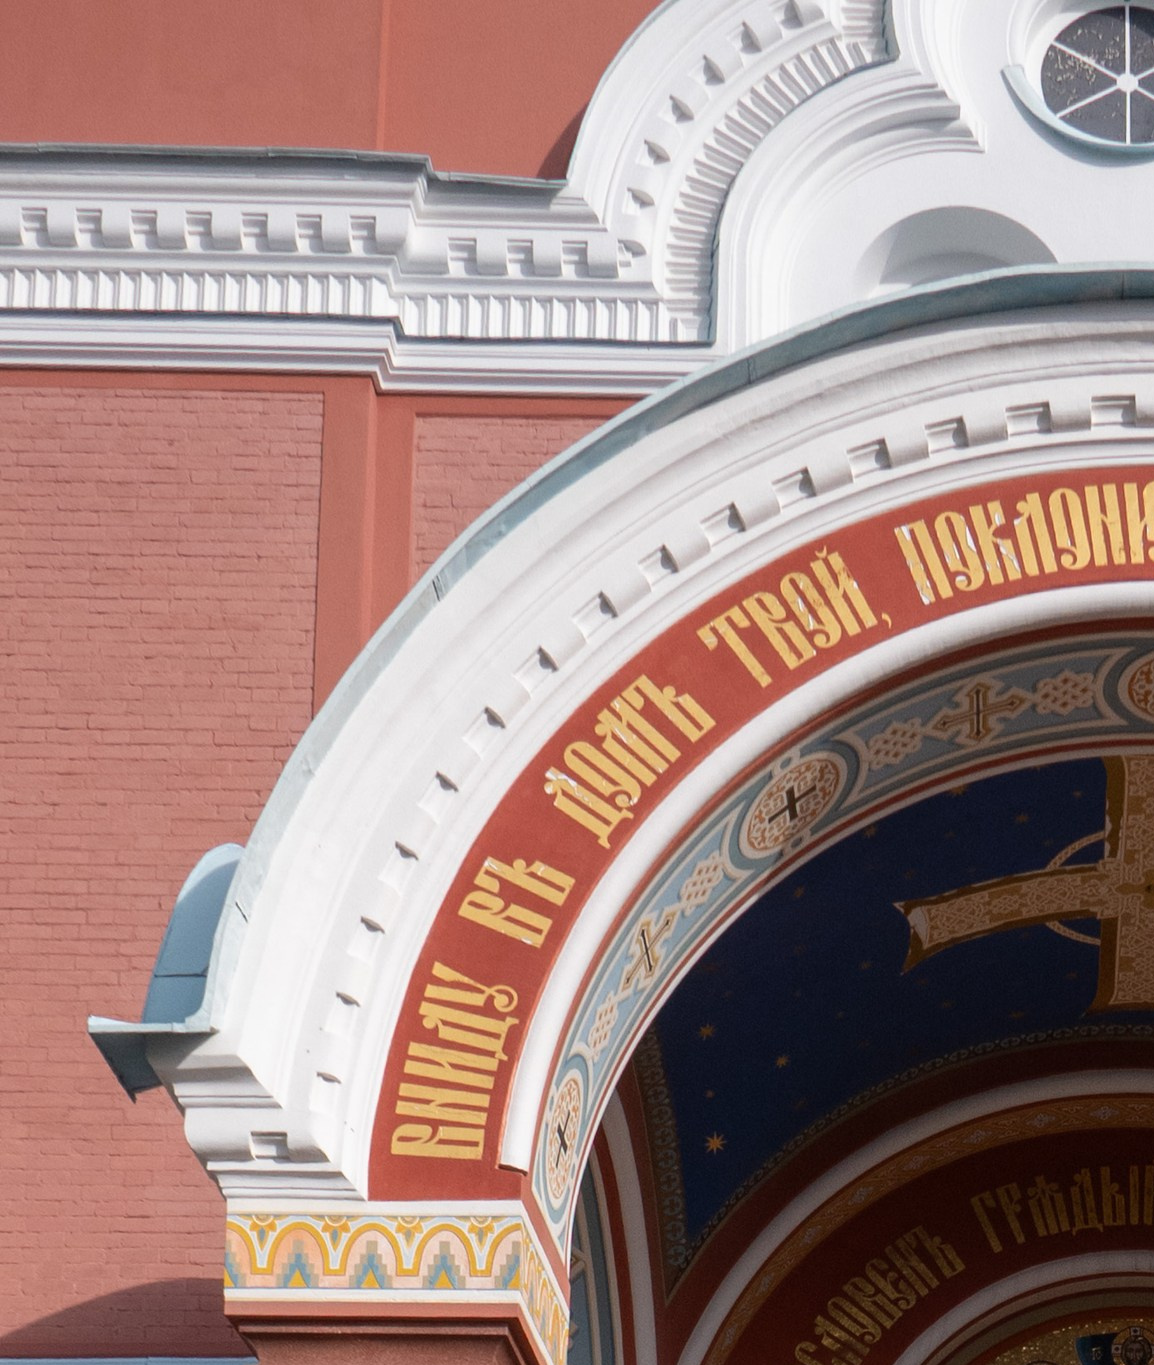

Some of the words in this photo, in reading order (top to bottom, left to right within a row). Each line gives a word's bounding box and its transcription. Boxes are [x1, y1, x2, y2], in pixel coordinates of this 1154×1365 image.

[391, 961, 519, 1160] ВНИДУ
[458, 855, 575, 949] ВЪ
[544, 674, 716, 849] ДОМЪ
[697, 546, 893, 689] ТВОЙ,
